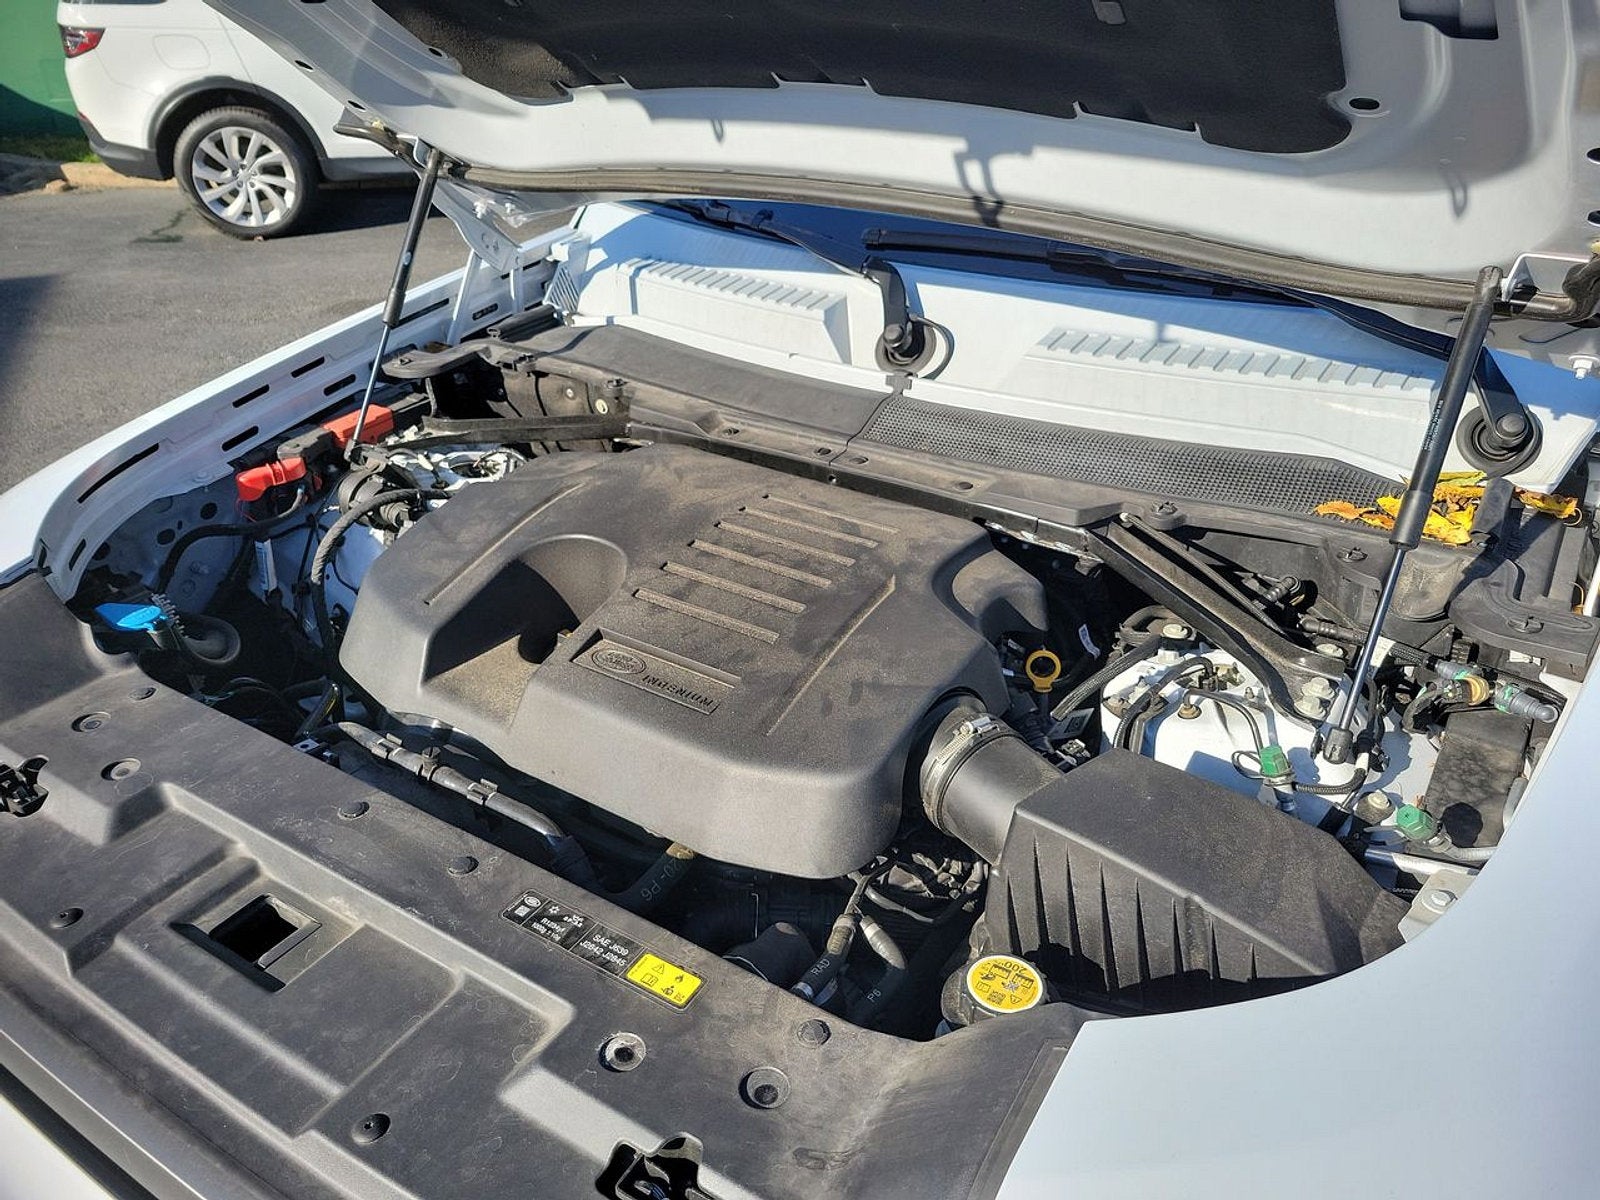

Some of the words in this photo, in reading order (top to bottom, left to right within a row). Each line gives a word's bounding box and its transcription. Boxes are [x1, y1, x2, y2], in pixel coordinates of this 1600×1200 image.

[579, 939, 604, 956] J2842
[592, 933, 612, 947] SAE
[608, 942, 630, 957] J639
[810, 958, 831, 976] RAD
